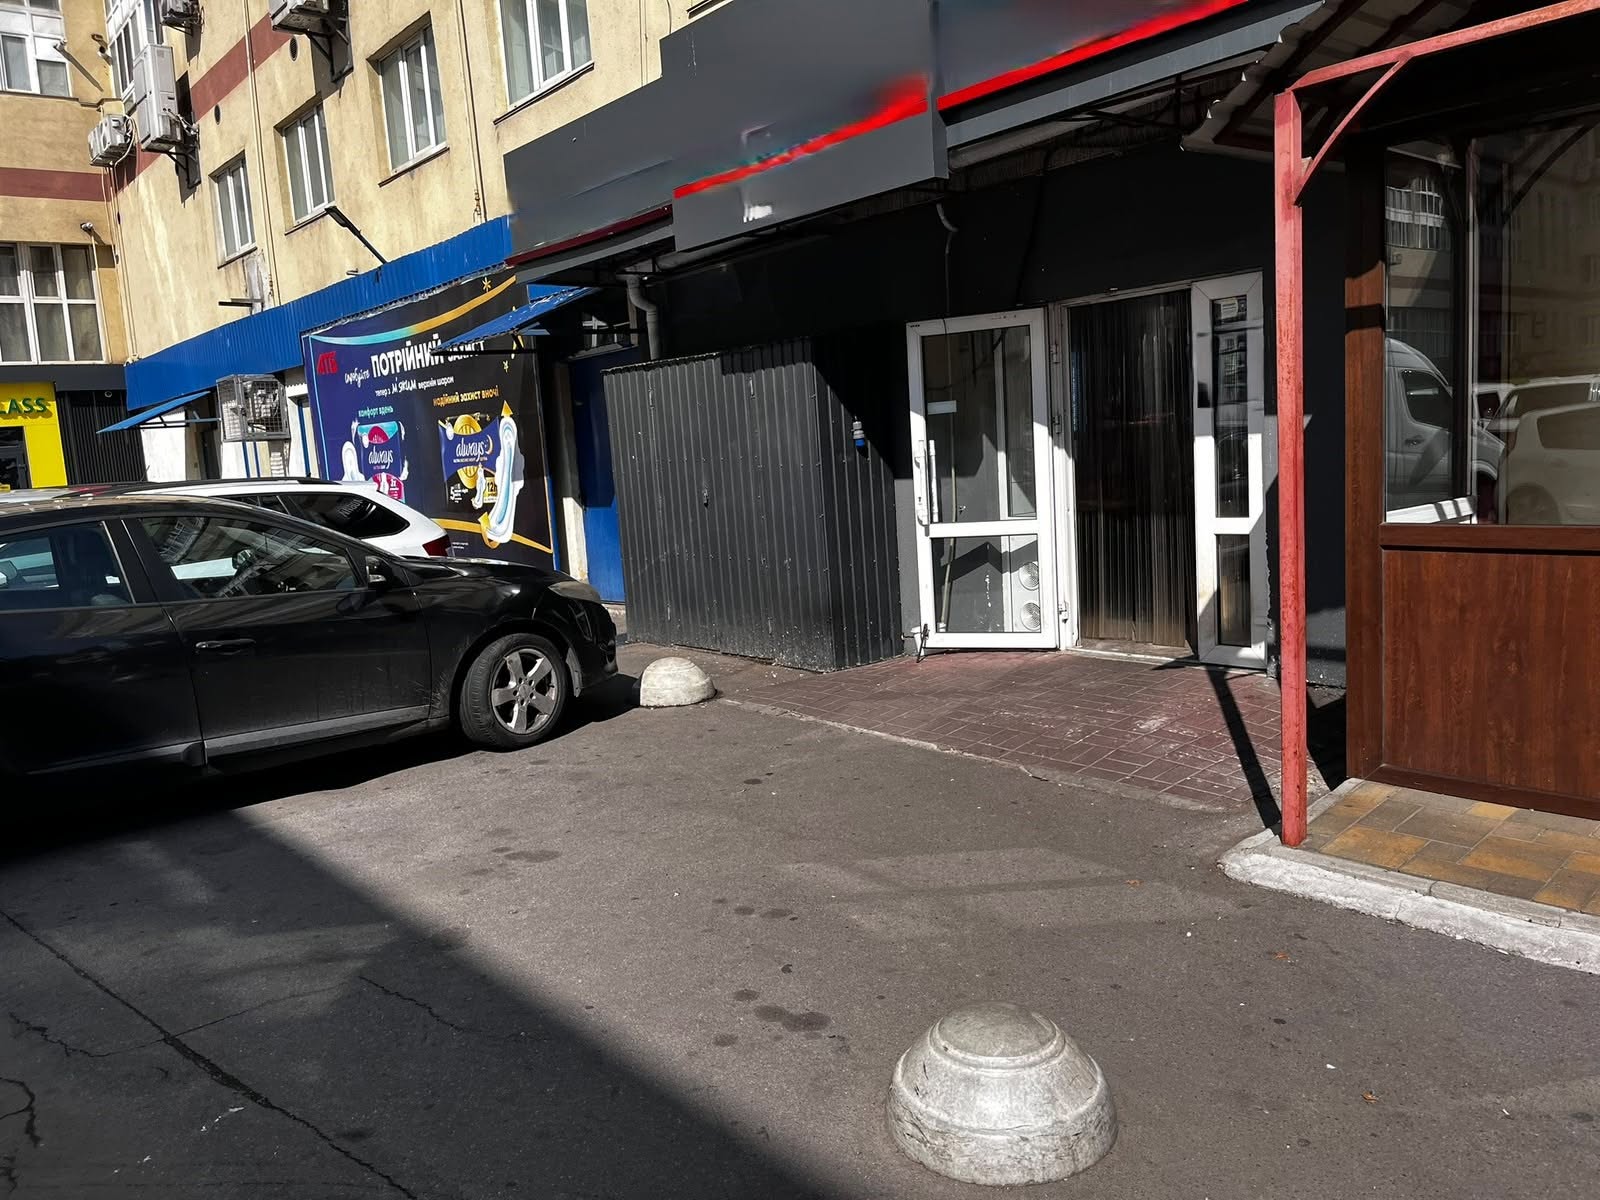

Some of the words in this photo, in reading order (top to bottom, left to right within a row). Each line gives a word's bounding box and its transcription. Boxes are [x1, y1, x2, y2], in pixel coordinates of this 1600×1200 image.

[370, 333, 445, 378] ПОТРІЙНИЙ
[368, 445, 394, 470] always
[455, 437, 485, 462] always
